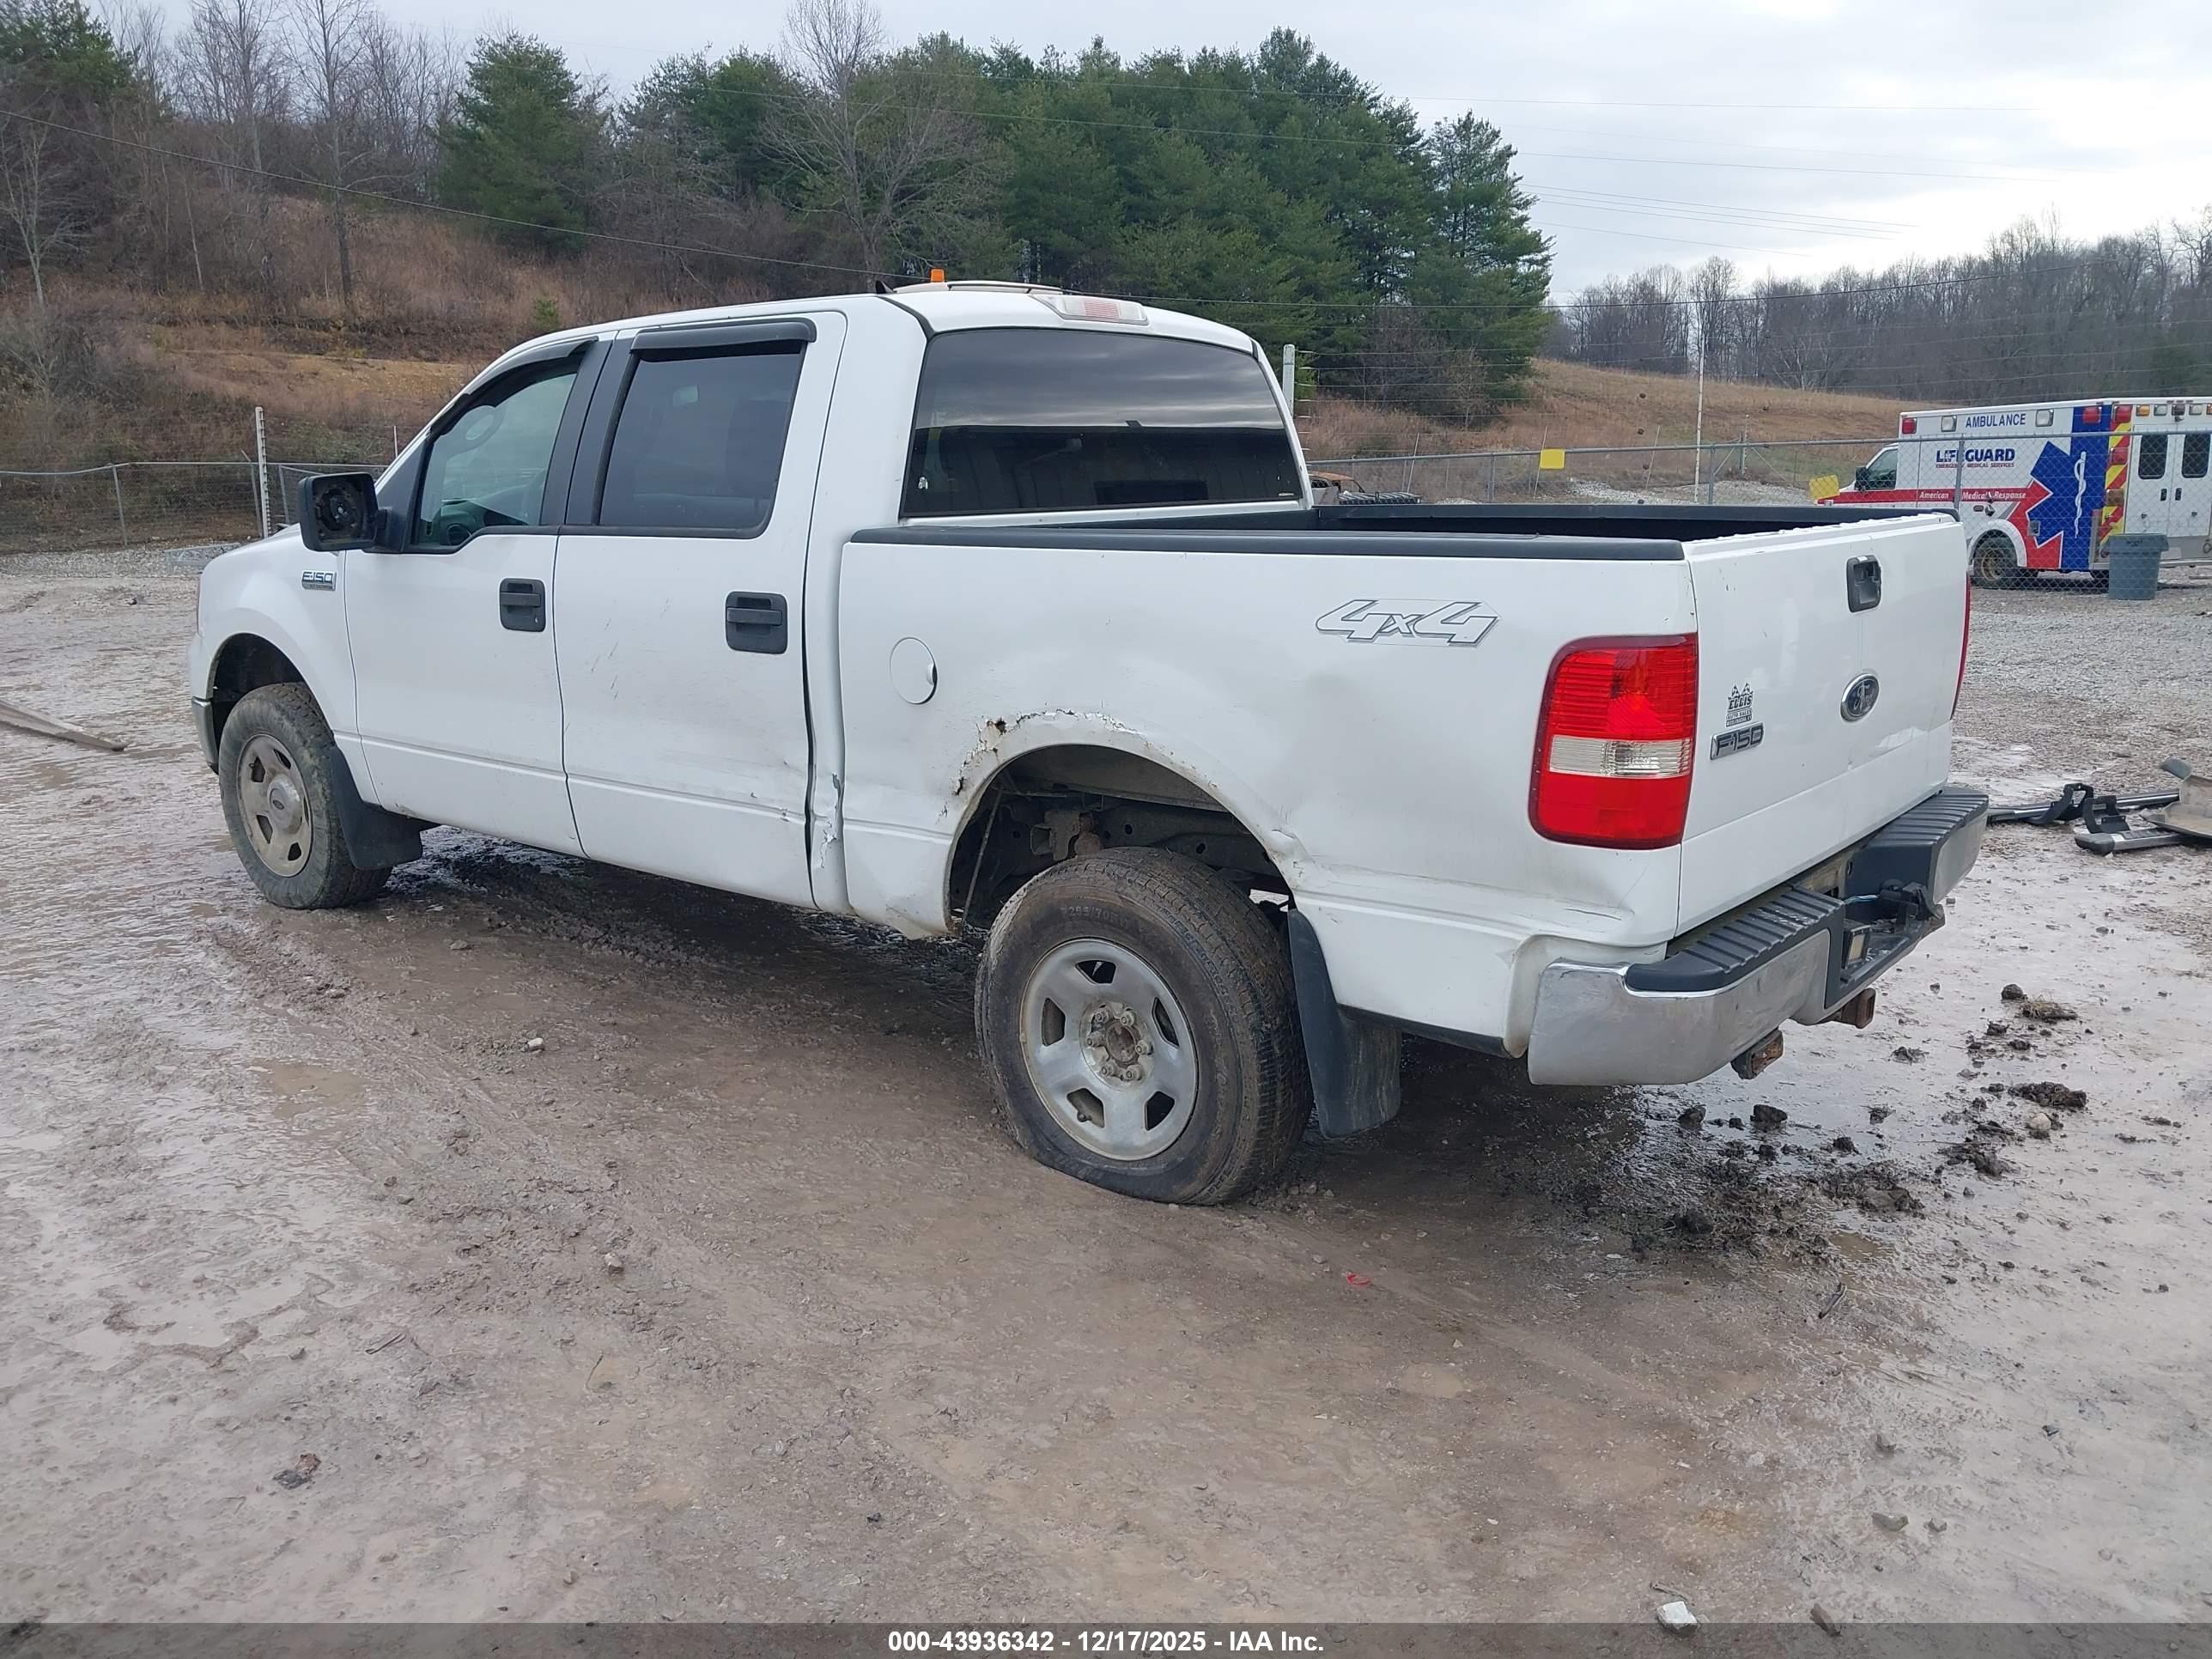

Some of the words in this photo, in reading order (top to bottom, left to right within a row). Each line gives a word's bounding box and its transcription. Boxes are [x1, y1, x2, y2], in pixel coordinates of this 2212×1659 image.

[1965, 413, 2027, 428] AMBULANCE
[1919, 490, 1949, 500] American
[1961, 490, 1988, 501] Medical
[1993, 490, 2027, 501] Response
